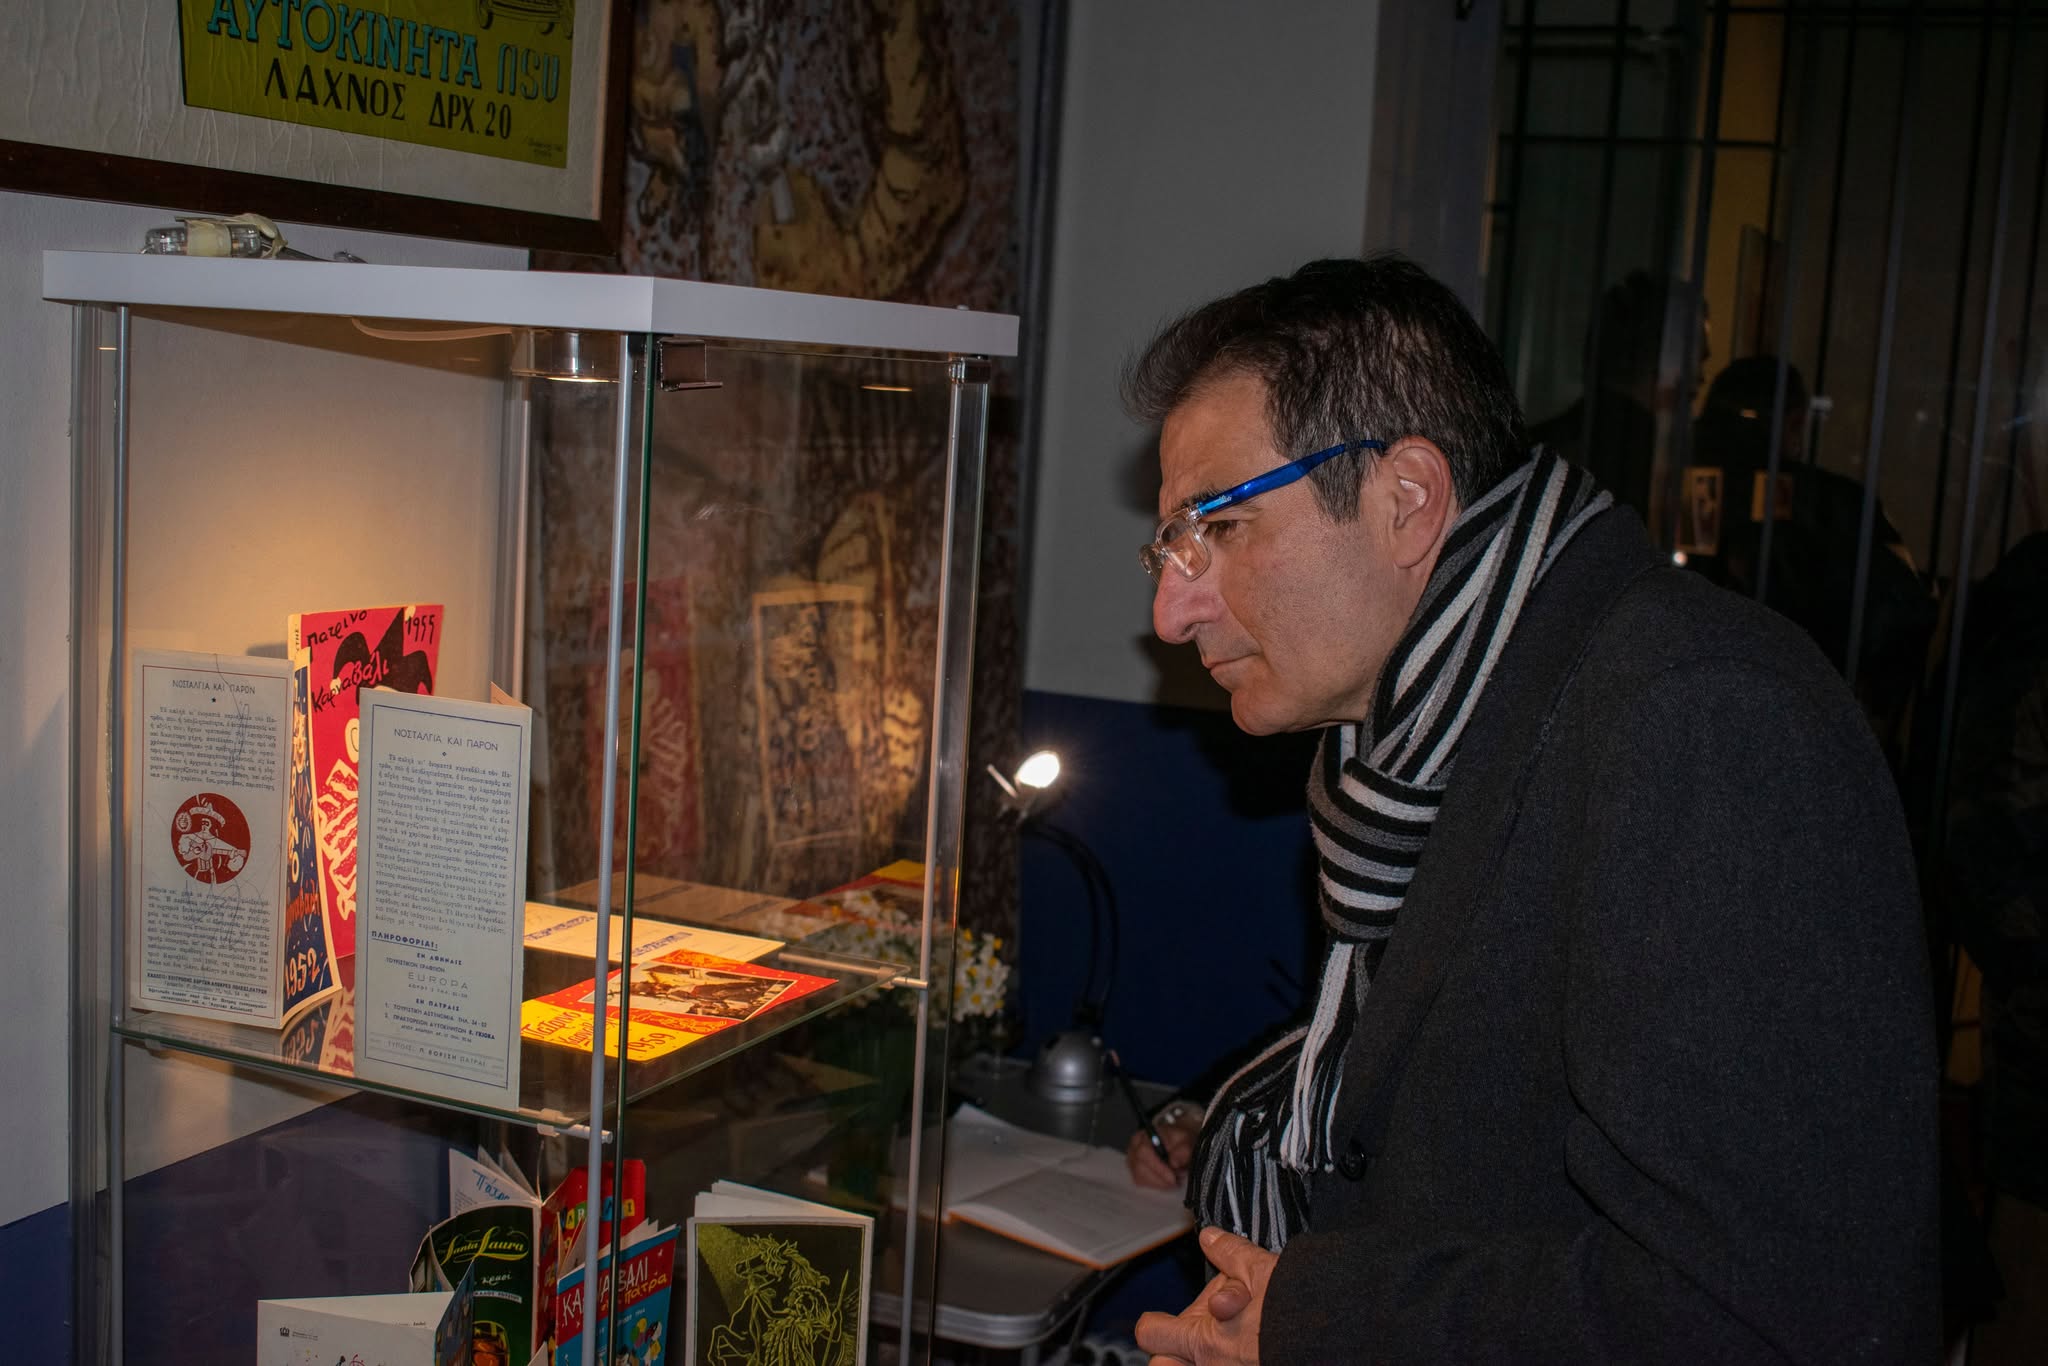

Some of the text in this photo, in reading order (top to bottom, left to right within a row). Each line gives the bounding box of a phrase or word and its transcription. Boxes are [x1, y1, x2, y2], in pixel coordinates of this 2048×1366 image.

[207, 0, 482, 89] ΑΥΤΟΚΙΝΗΤΑ
[265, 57, 406, 121] ΛΑΧΝΟΣ
[405, 614, 435, 645] 1955
[393, 728, 499, 751] ΝΟΣΤΑΛΓΙΑ ΚΑΙ ΠΑΡΟΝ
[407, 971, 468, 989] EUROPA
[628, 1032, 676, 1053] 1959
[473, 1226, 529, 1261] Laura
